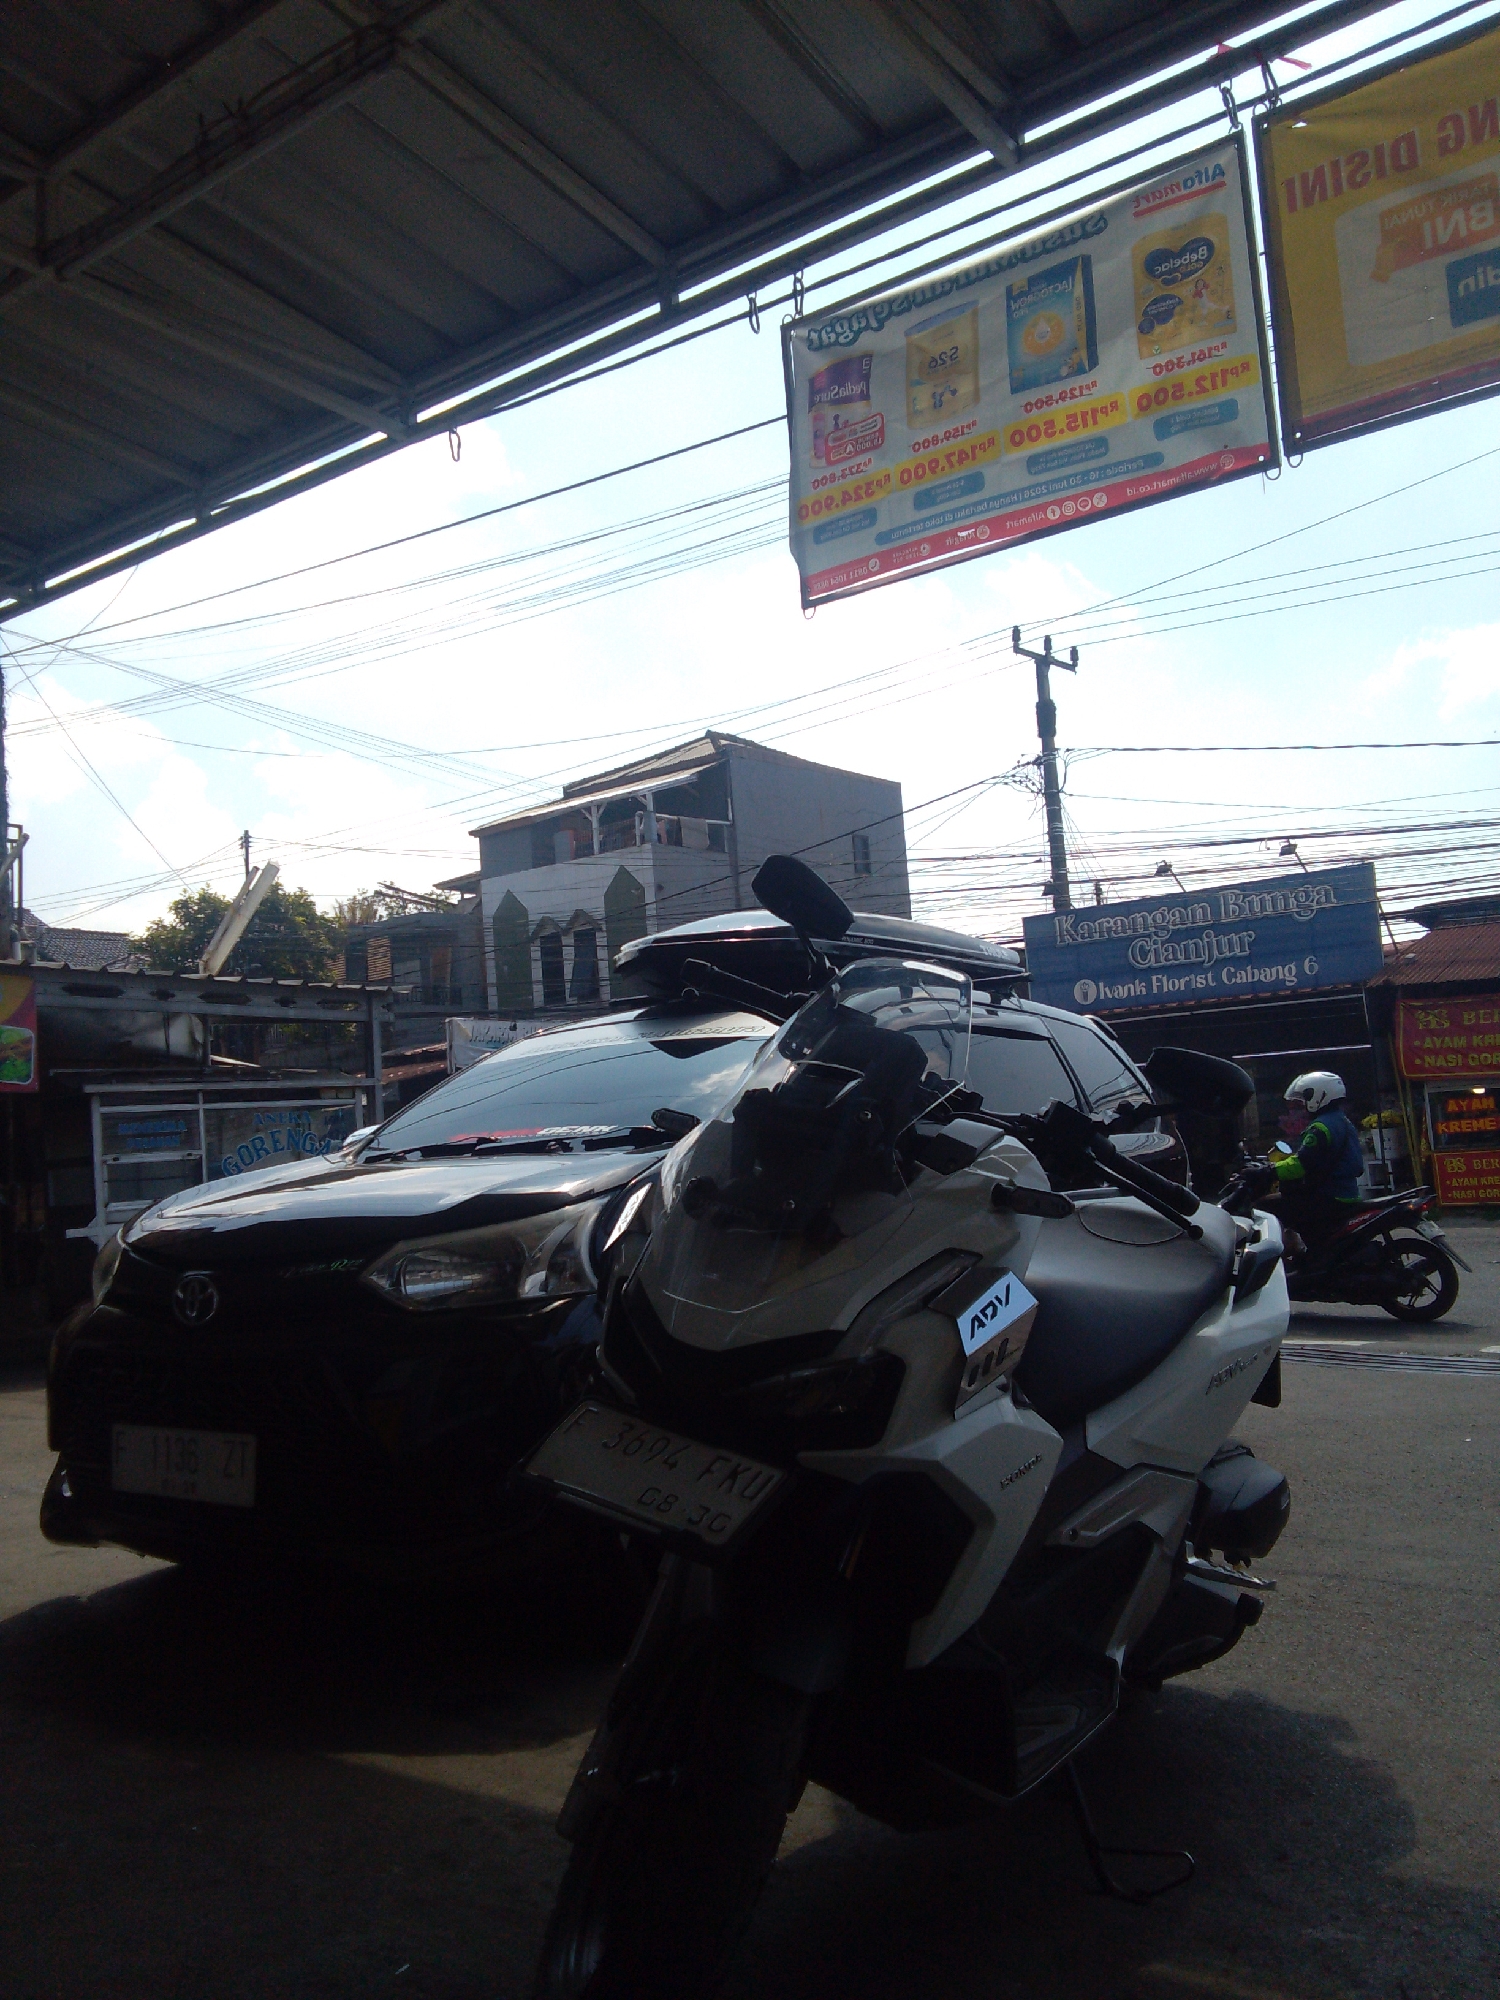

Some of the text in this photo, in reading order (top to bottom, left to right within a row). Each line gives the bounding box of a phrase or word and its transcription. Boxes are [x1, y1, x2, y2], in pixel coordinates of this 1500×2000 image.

[1054, 885, 1338, 946] Karangan Bunga
[1129, 929, 1255, 969] Cianjur
[1099, 956, 1319, 1000] Ivank Florist Cabang 6
[1423, 1036, 1467, 1049] AYAM
[1424, 1054, 1463, 1067] NASI
[1447, 1096, 1495, 1112] AYAM
[253, 1111, 311, 1126] ANEKA
[1452, 1177, 1478, 1187] AYAM
[1453, 1188, 1477, 1199] NASI
[970, 1282, 1010, 1341] ADV
[115, 1430, 126, 1465] F
[223, 1439, 250, 1479] ZT
[562, 1406, 776, 1502] F 3694 FKU
